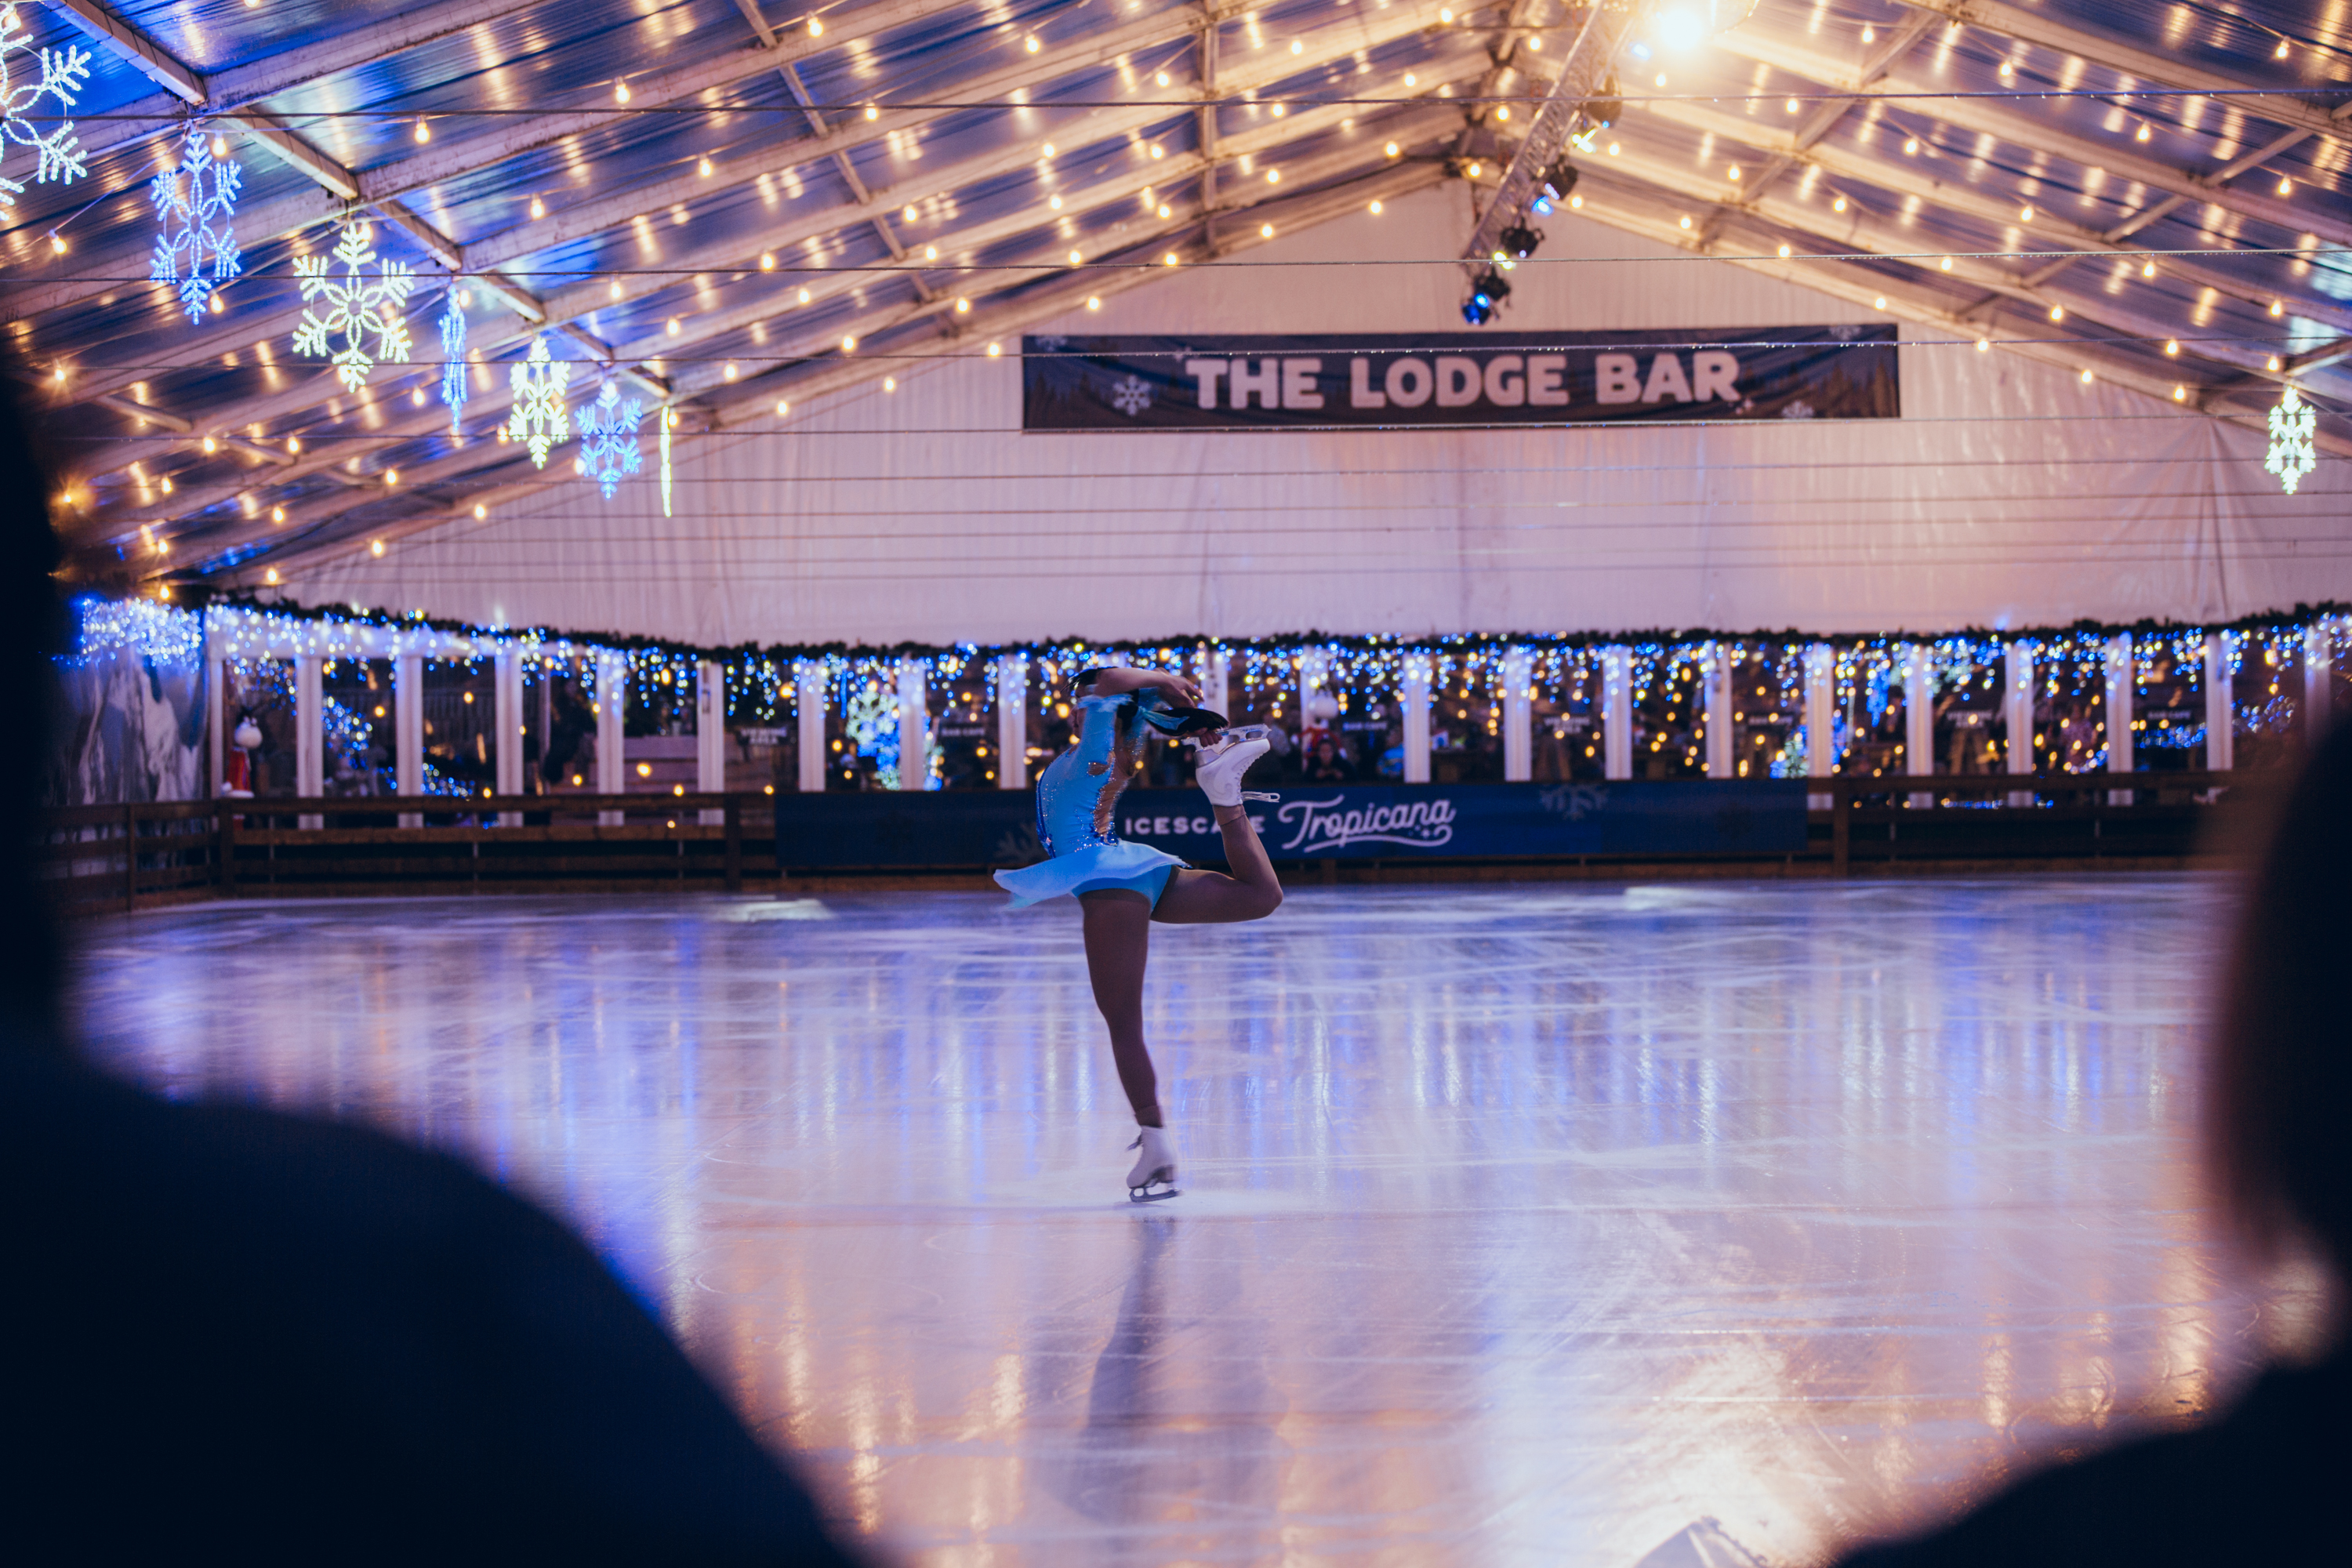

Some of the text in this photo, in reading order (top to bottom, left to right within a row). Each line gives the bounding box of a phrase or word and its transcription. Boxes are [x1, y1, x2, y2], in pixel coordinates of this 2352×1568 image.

[1185, 350, 1741, 409] THE LODGE BAR
[1124, 793, 1457, 853] ICESCE Tropicana
